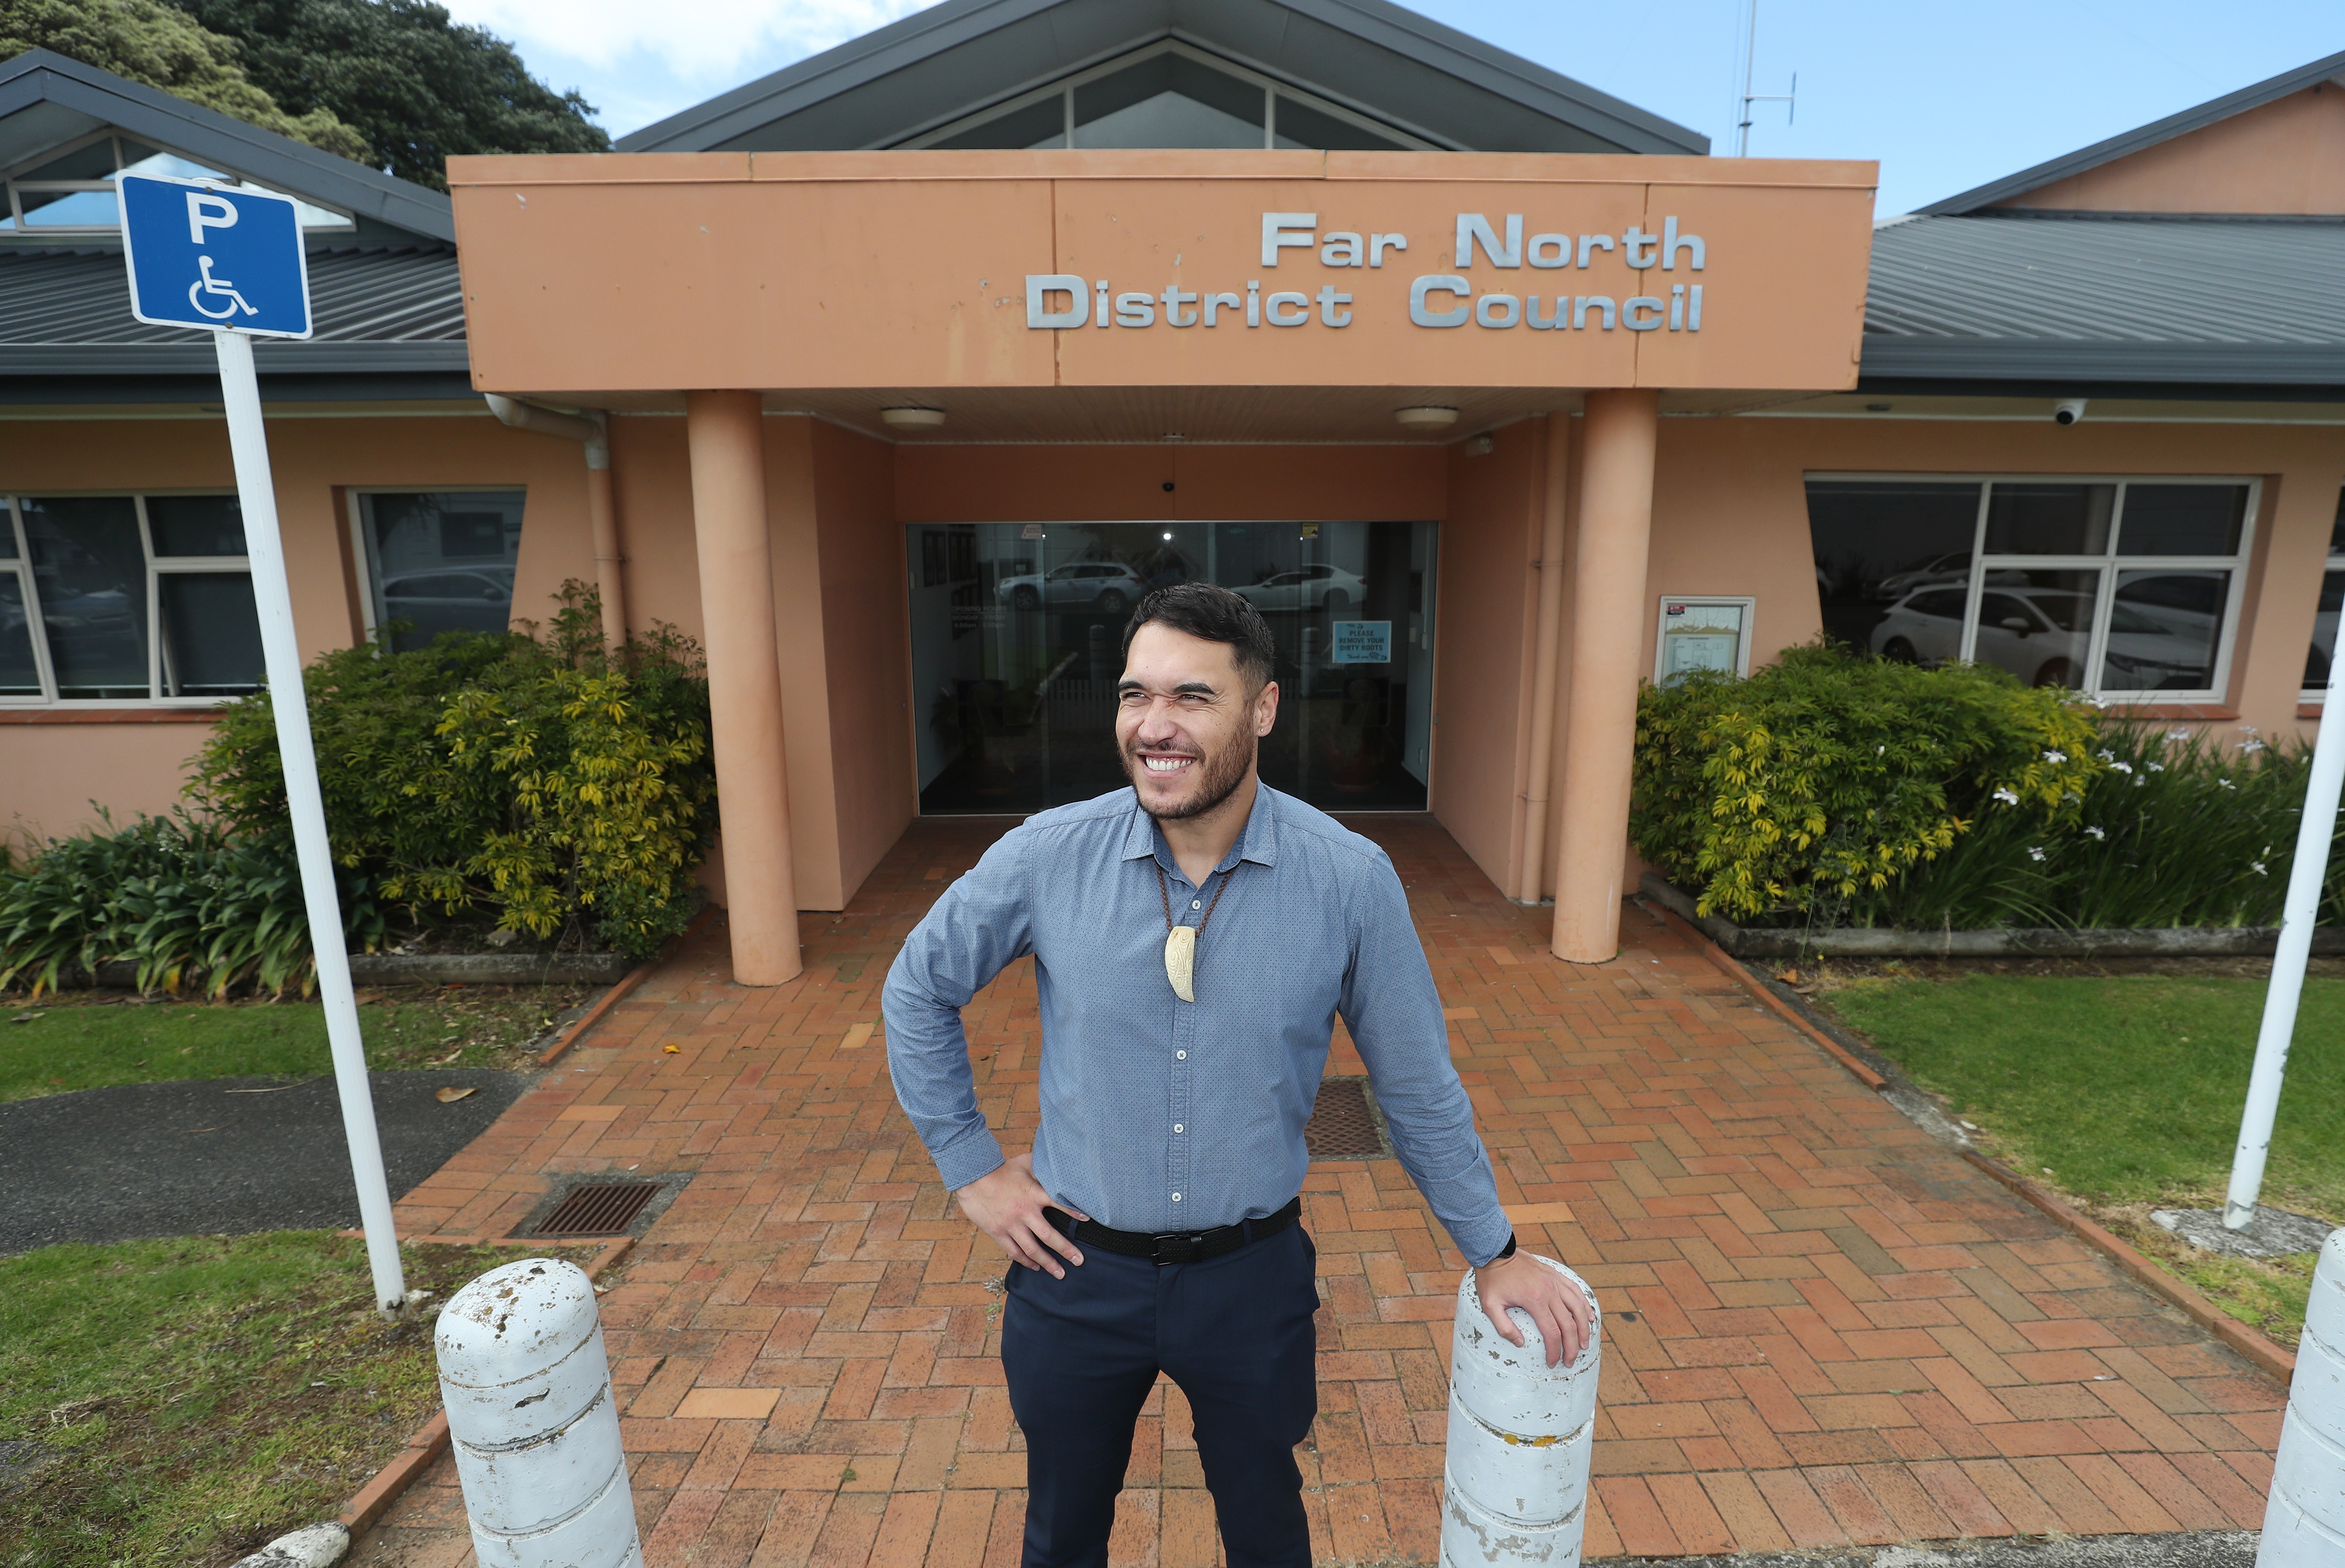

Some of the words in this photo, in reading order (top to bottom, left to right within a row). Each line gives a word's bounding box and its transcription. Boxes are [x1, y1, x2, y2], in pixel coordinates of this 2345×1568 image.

[185, 191, 239, 245] P
[1261, 212, 1407, 268] Far
[1455, 213, 1706, 270] North
[1025, 274, 1352, 329] District
[1410, 274, 1703, 331] Council
